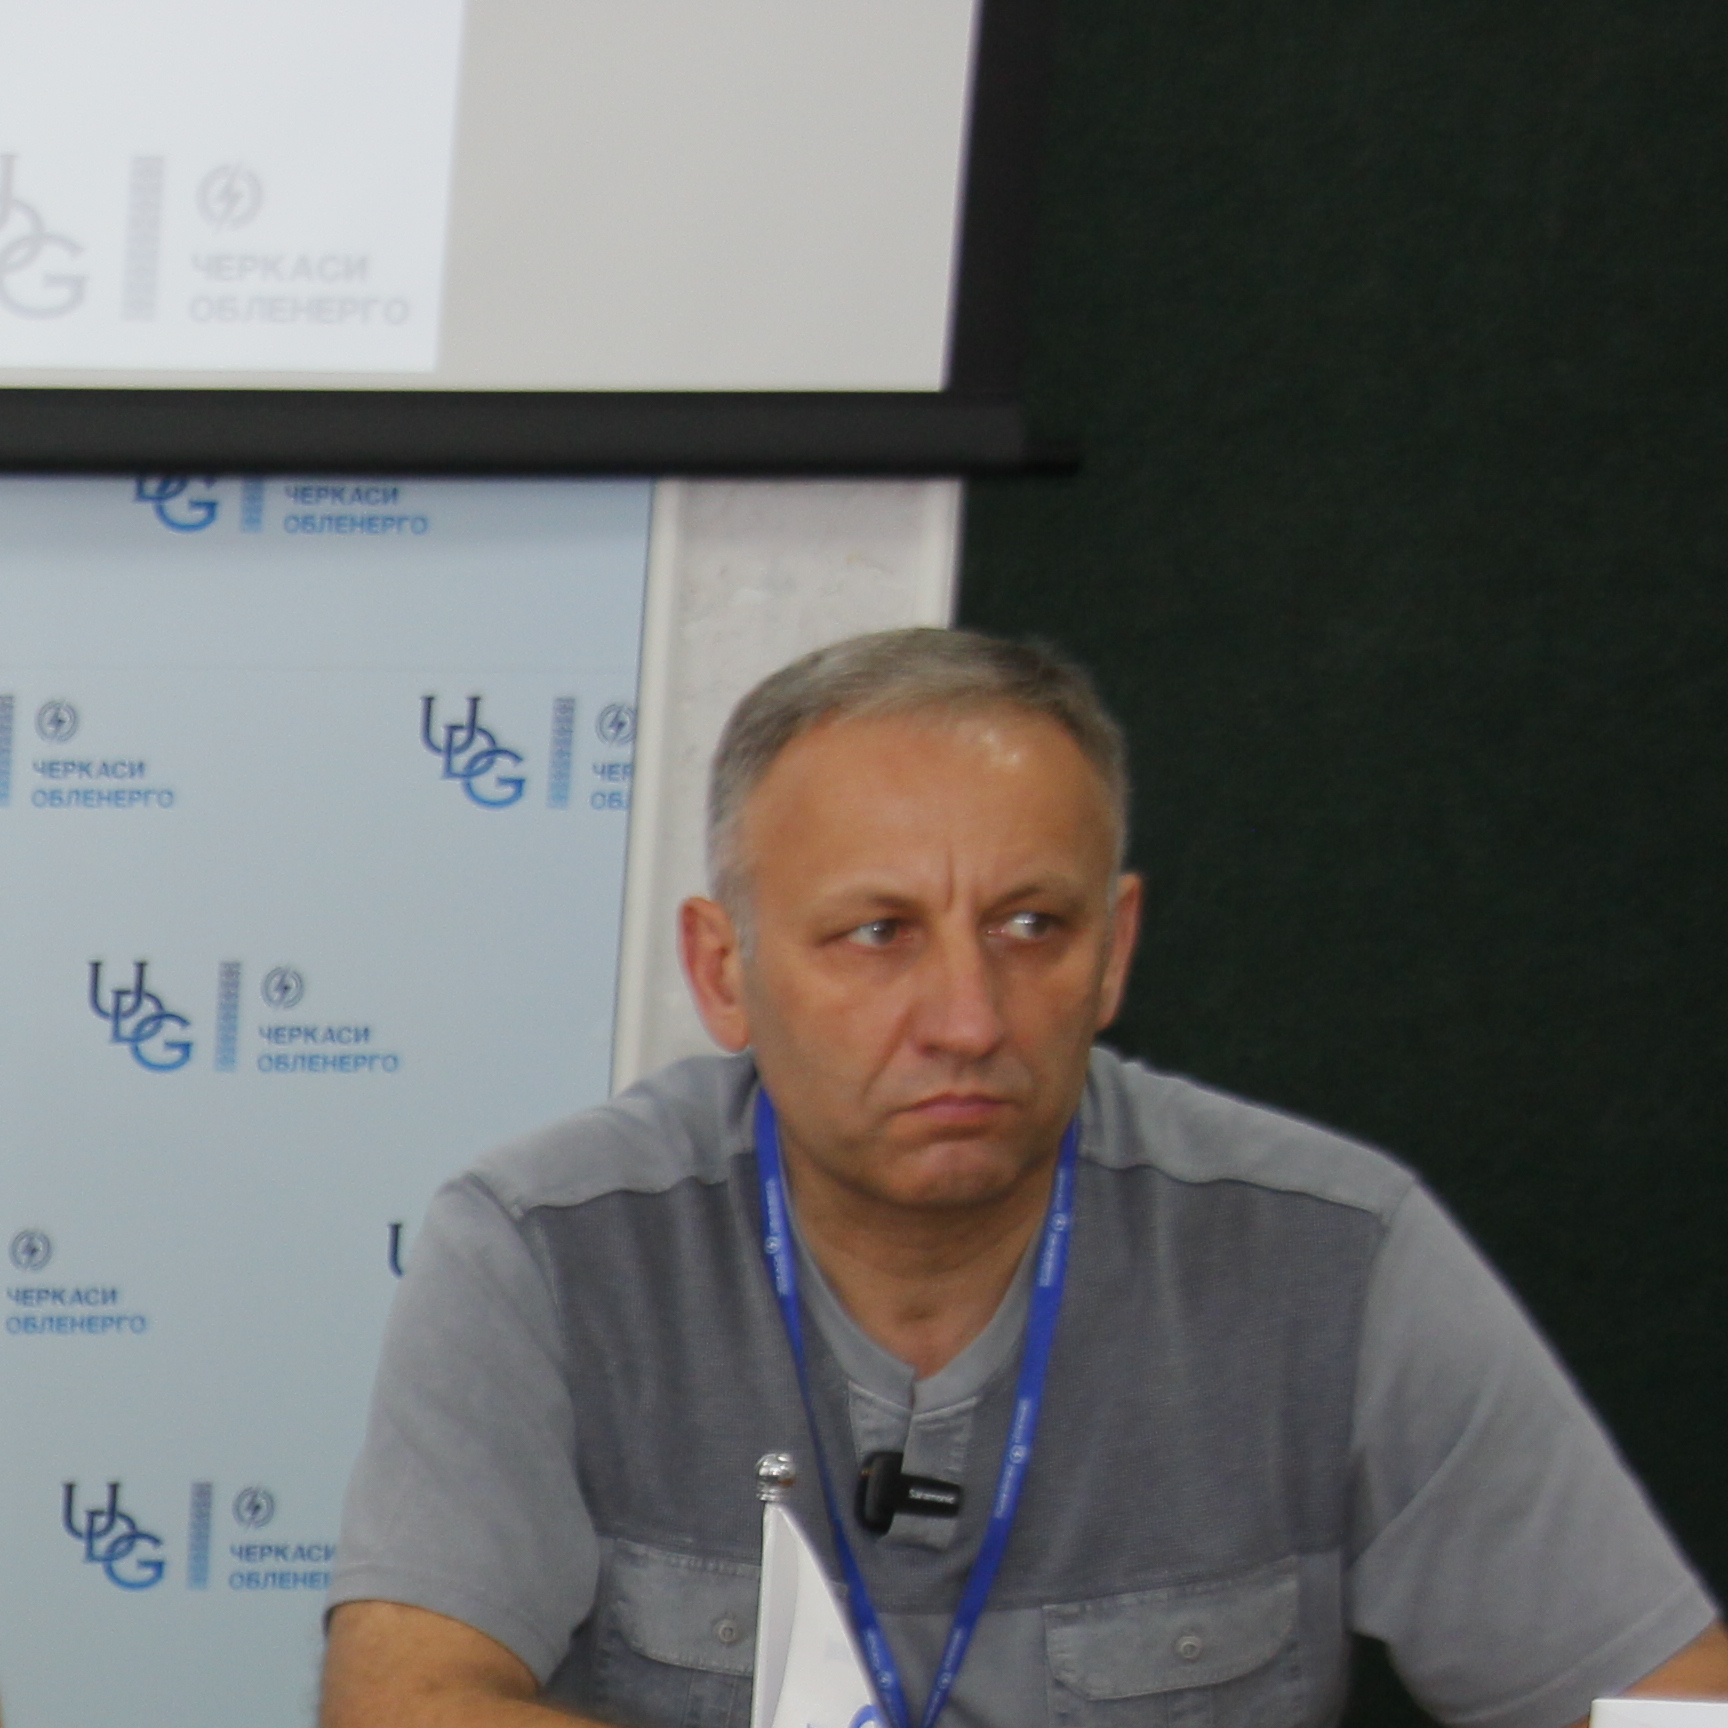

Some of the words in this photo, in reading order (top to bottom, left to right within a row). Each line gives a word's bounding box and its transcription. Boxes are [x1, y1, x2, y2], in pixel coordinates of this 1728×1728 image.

[192, 254, 369, 283] ЧЕРКАСИ
[189, 297, 410, 325] ОБЛЕНЕРГО
[284, 486, 400, 506] ЧЕРКАСИ
[284, 513, 430, 534] ОБЛЕНЕРГО
[33, 759, 146, 779] ЧЕРКАСИ
[32, 788, 175, 808] ОБЛЕНЕРГО
[259, 1025, 372, 1044] ЧЕРКАСИ
[257, 1053, 401, 1073] ОБЛЕНЕРГО
[8, 1288, 119, 1307] ЧЕРКАСИ
[6, 1315, 147, 1335] ОБЛЕНЕРГО
[229, 1570, 331, 1590] ОБЛЕНЕ
